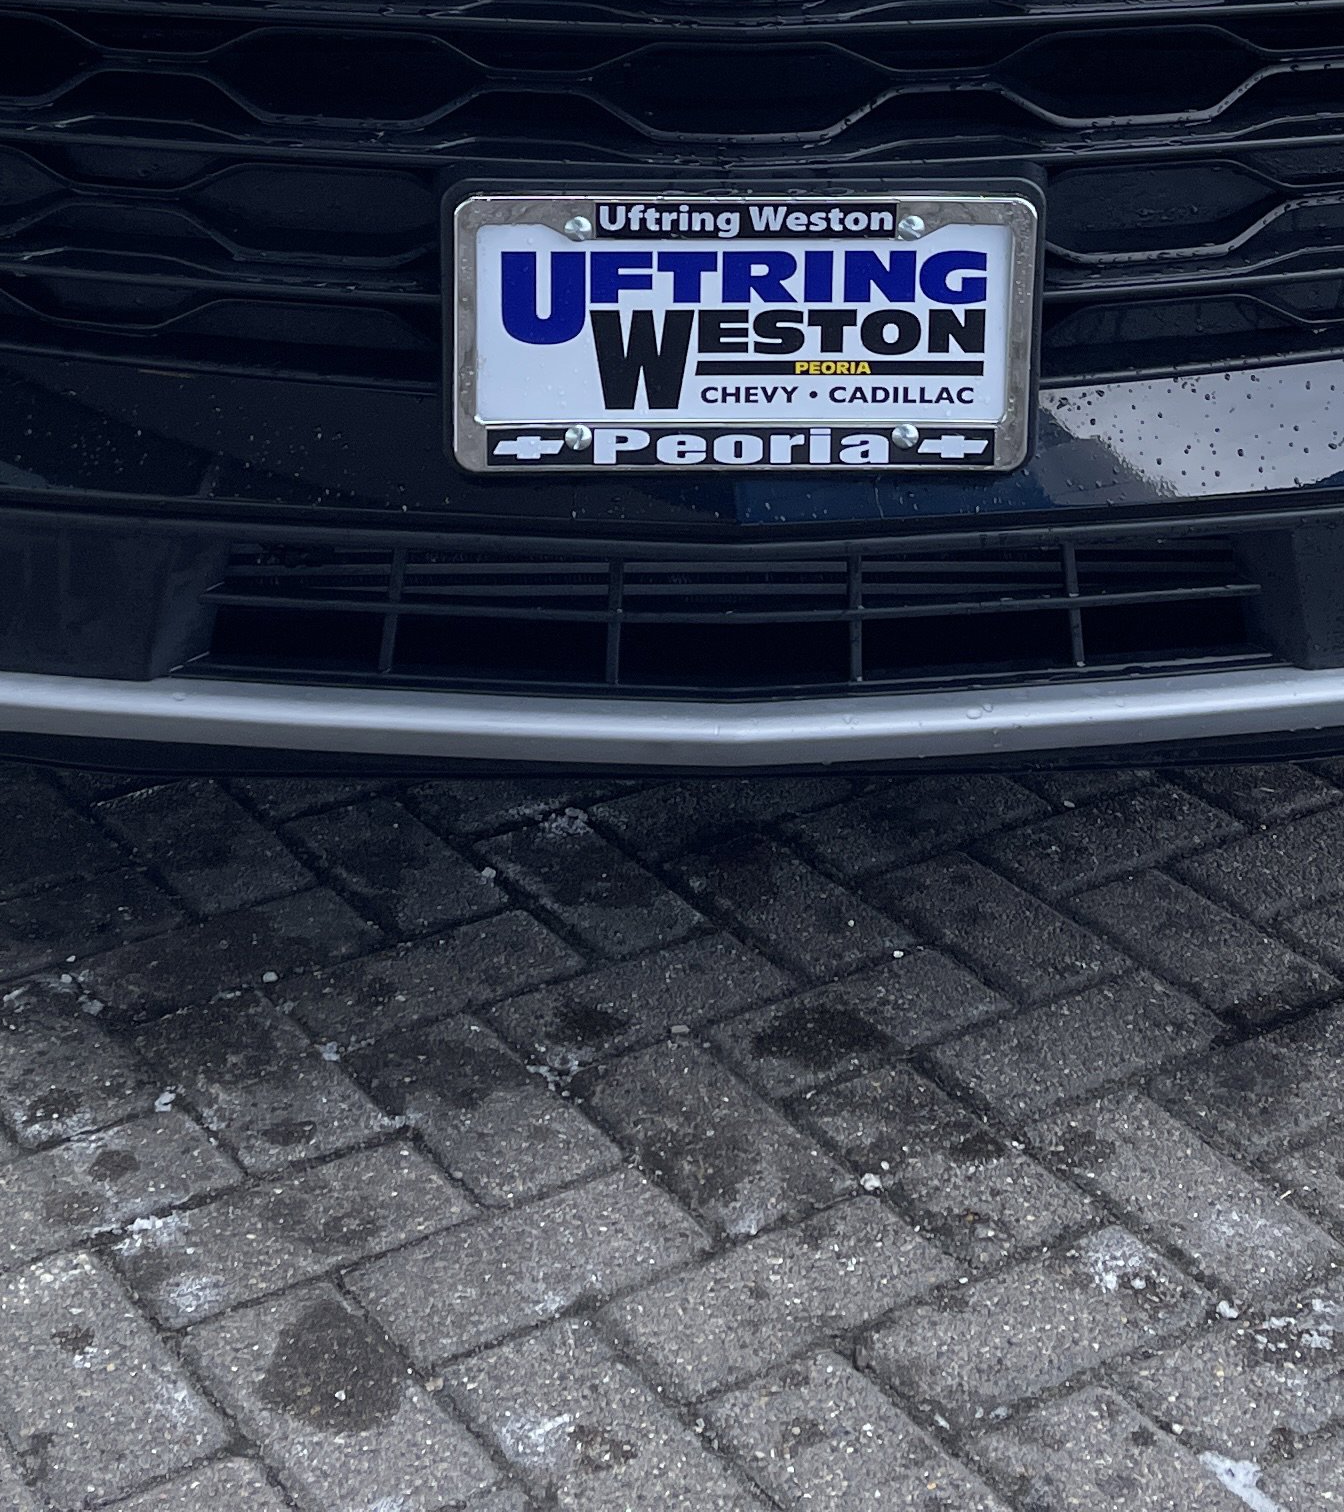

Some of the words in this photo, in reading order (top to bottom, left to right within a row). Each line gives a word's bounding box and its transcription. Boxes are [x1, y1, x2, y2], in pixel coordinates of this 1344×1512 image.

[599, 204, 740, 238] Uftring
[748, 205, 894, 232] Weston
[500, 250, 988, 345] UFTRING
[590, 308, 986, 410] WESTON
[794, 361, 872, 375] PEORIA
[700, 385, 799, 404] CHEVY
[828, 385, 975, 405] CADILLAC
[592, 428, 890, 465] Peoria
